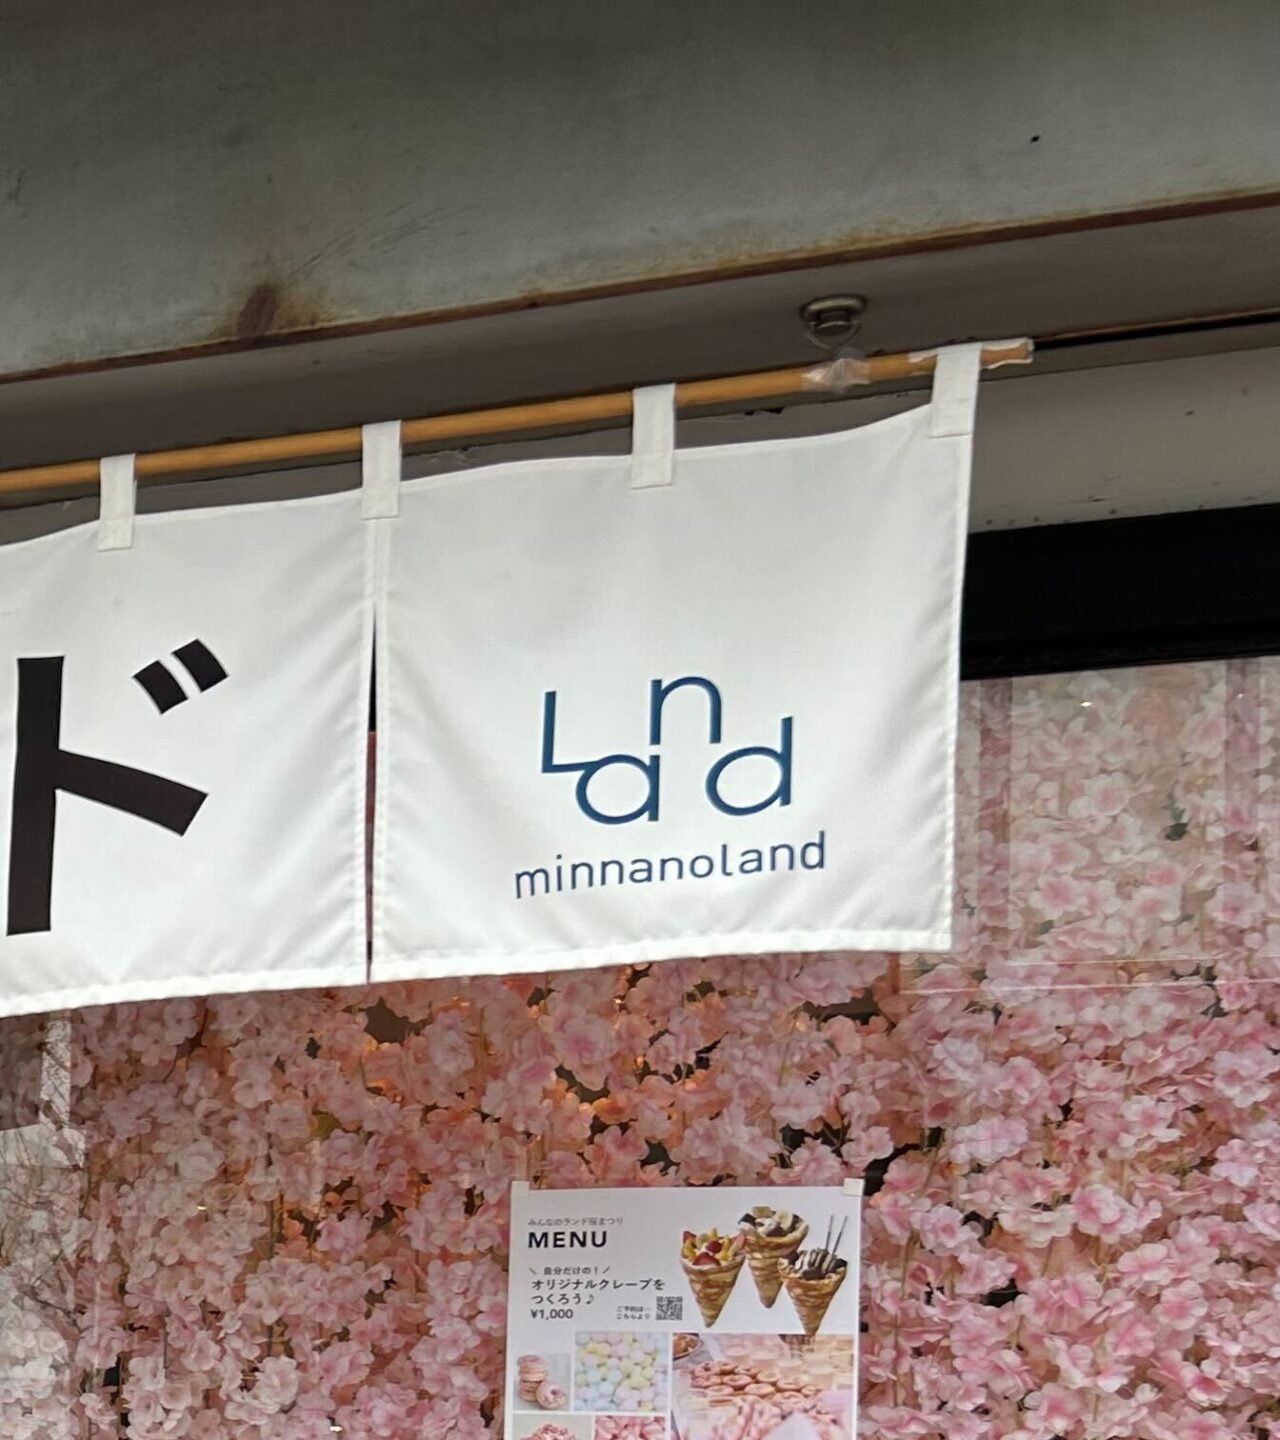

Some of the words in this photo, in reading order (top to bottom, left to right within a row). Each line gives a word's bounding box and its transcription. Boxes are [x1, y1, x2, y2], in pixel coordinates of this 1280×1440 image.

[514, 830, 826, 899] minnanoland
[528, 1230, 608, 1249] MENU
[531, 1277, 666, 1291] オリジナルクレープを
[530, 1308, 574, 1321] ¥1,000
